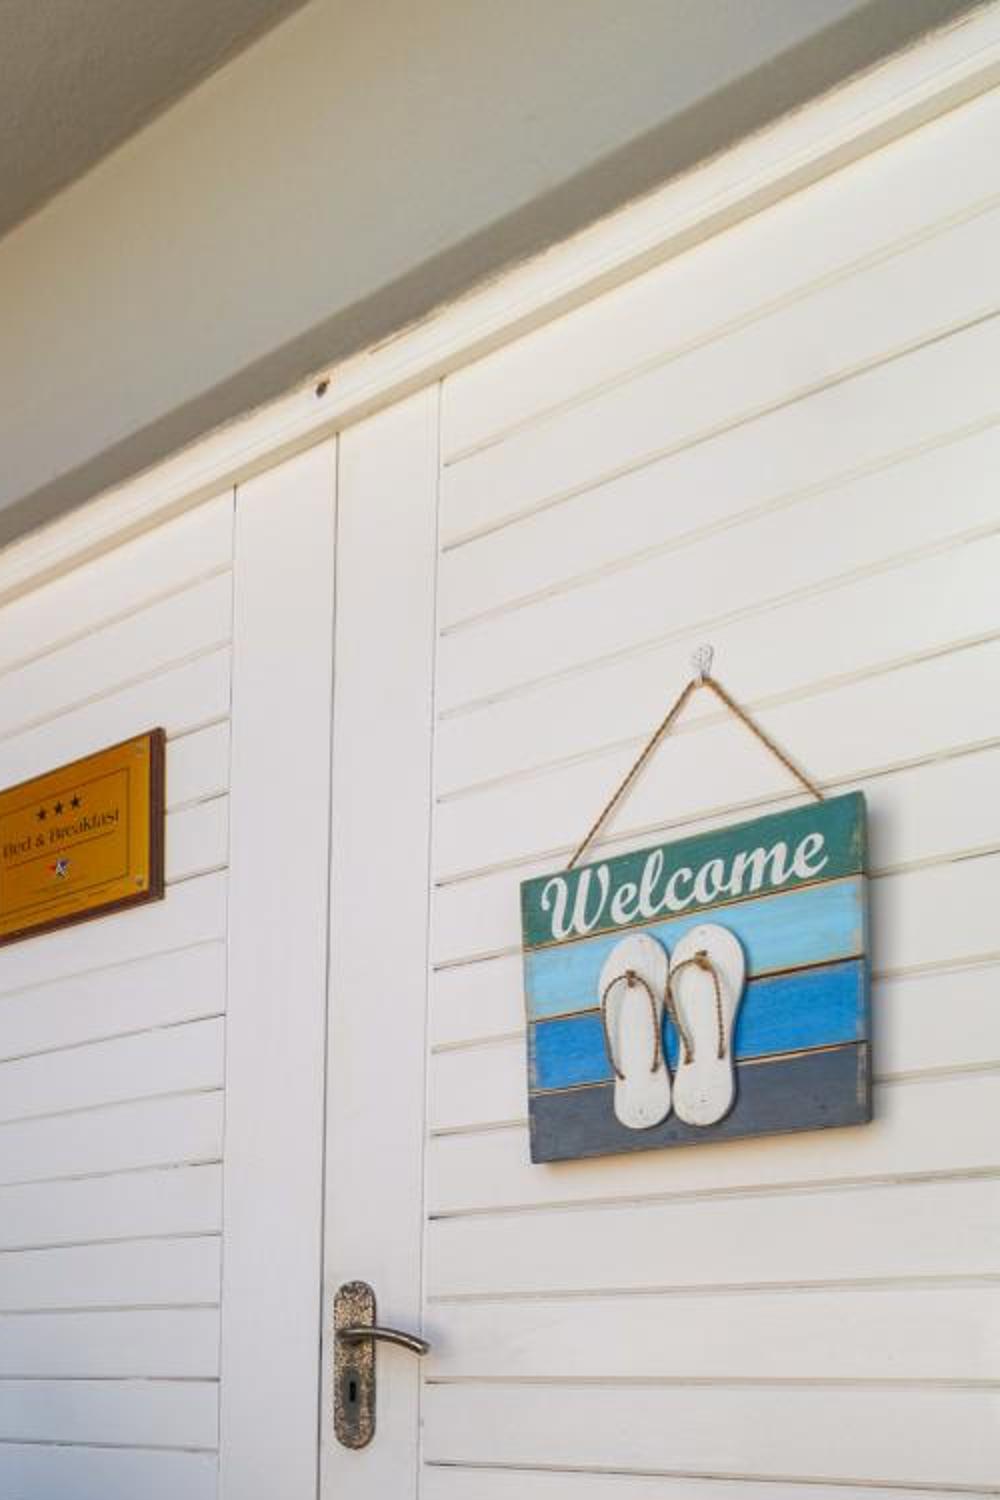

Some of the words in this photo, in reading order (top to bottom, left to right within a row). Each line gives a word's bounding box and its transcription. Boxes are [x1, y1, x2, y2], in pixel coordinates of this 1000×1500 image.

[2, 836, 31, 858] Bed
[35, 833, 46, 848] &
[49, 807, 119, 843] Breakfast
[541, 832, 829, 940] Welcome
